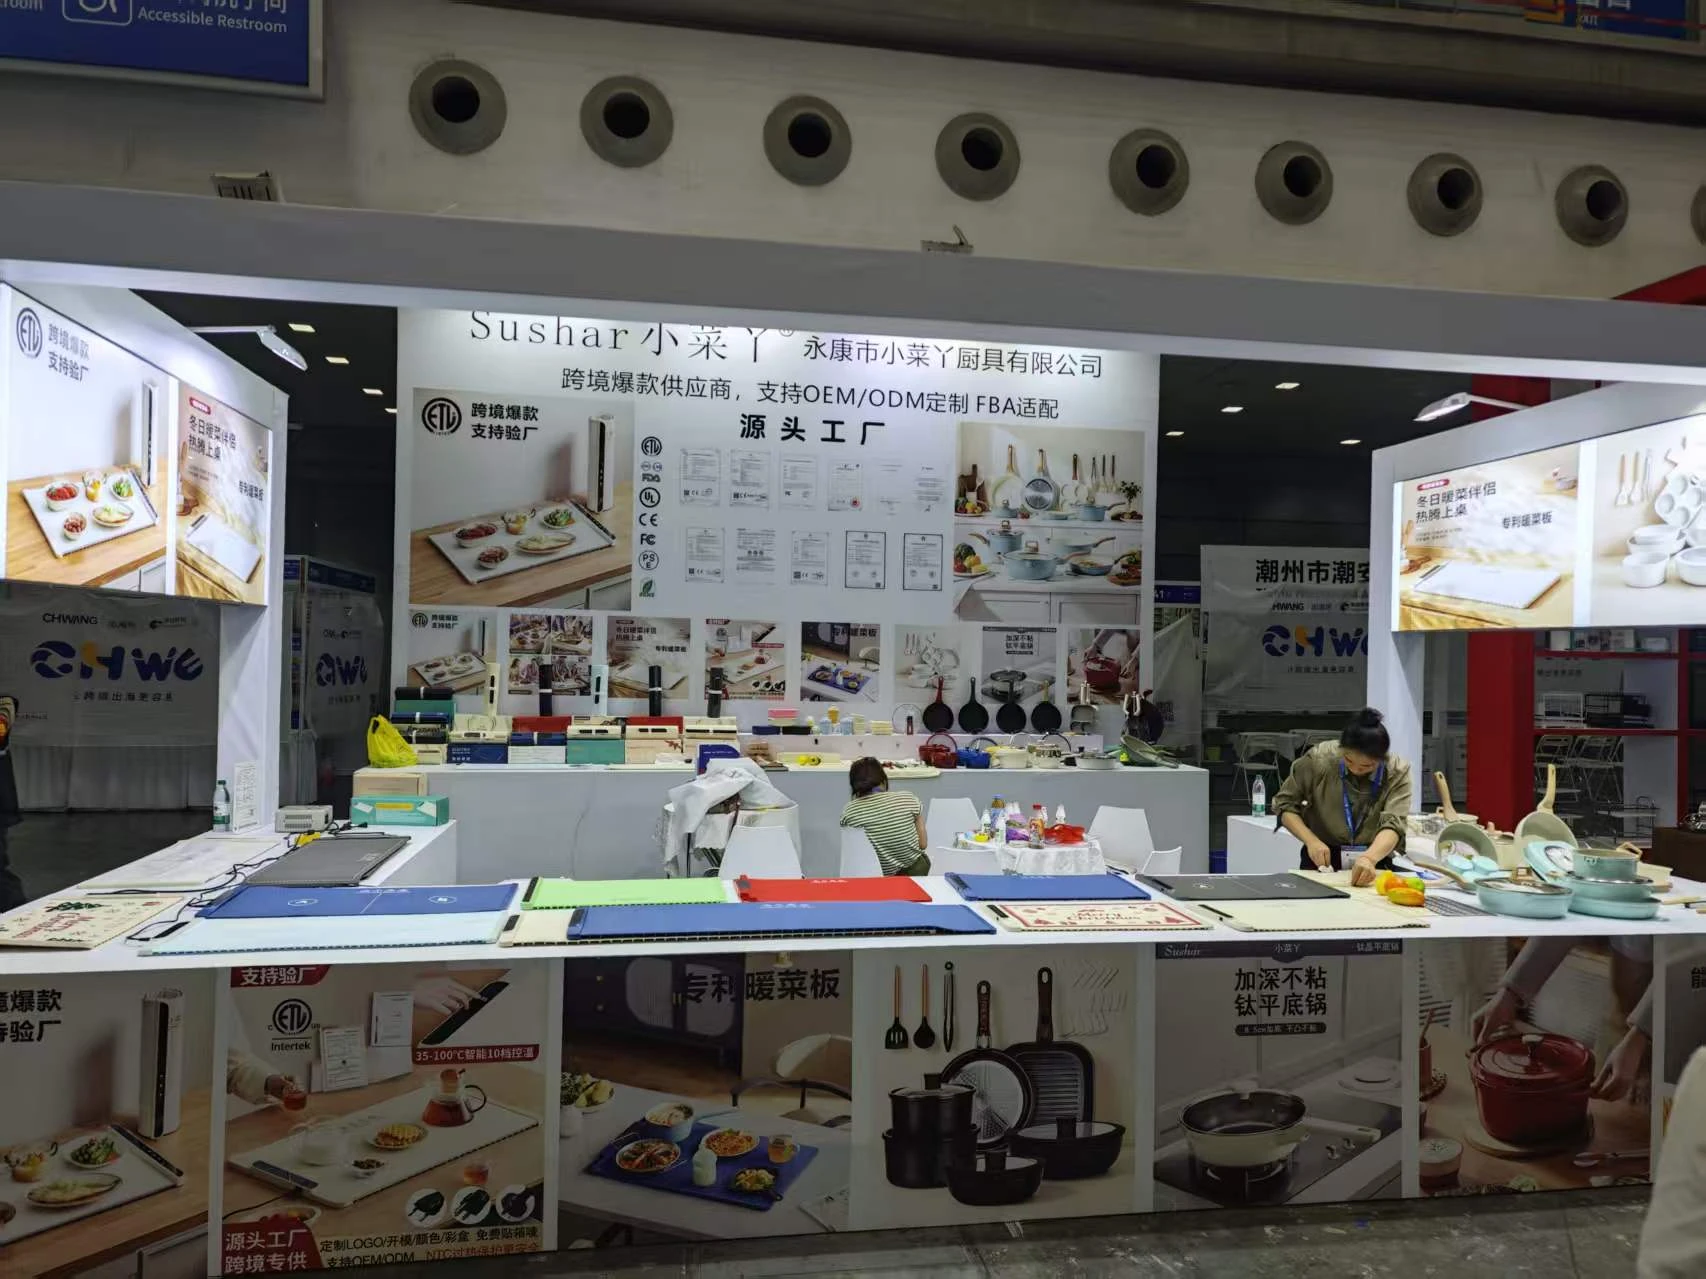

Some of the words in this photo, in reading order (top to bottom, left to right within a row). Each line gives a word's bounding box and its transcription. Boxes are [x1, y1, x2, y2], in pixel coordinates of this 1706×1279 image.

[138, 6, 214, 26] Accessible
[217, 14, 288, 33] Restroom
[470, 310, 629, 350] Sushar
[803, 335, 1102, 378] 永康市小菜丫厨具有限公司
[471, 402, 539, 422] 跨境爆款
[976, 395, 1060, 420] FBA适配
[470, 424, 539, 441] 支持验厂
[740, 412, 886, 446] 源头工厂
[639, 513, 659, 526] CE
[42, 612, 98, 625] CHWANG
[1271, 602, 1304, 611] HWANG
[239, 966, 317, 986] 支持验厂
[684, 968, 841, 1002] 专利暖菜板
[1234, 966, 1328, 992] 加深不粘
[1234, 993, 1328, 1017] 钛平底锅
[0, 1019, 62, 1043] 验厂
[270, 1041, 312, 1052] Intertek
[225, 1228, 308, 1251] 源头工厂
[224, 1251, 308, 1275] 跨境专供
